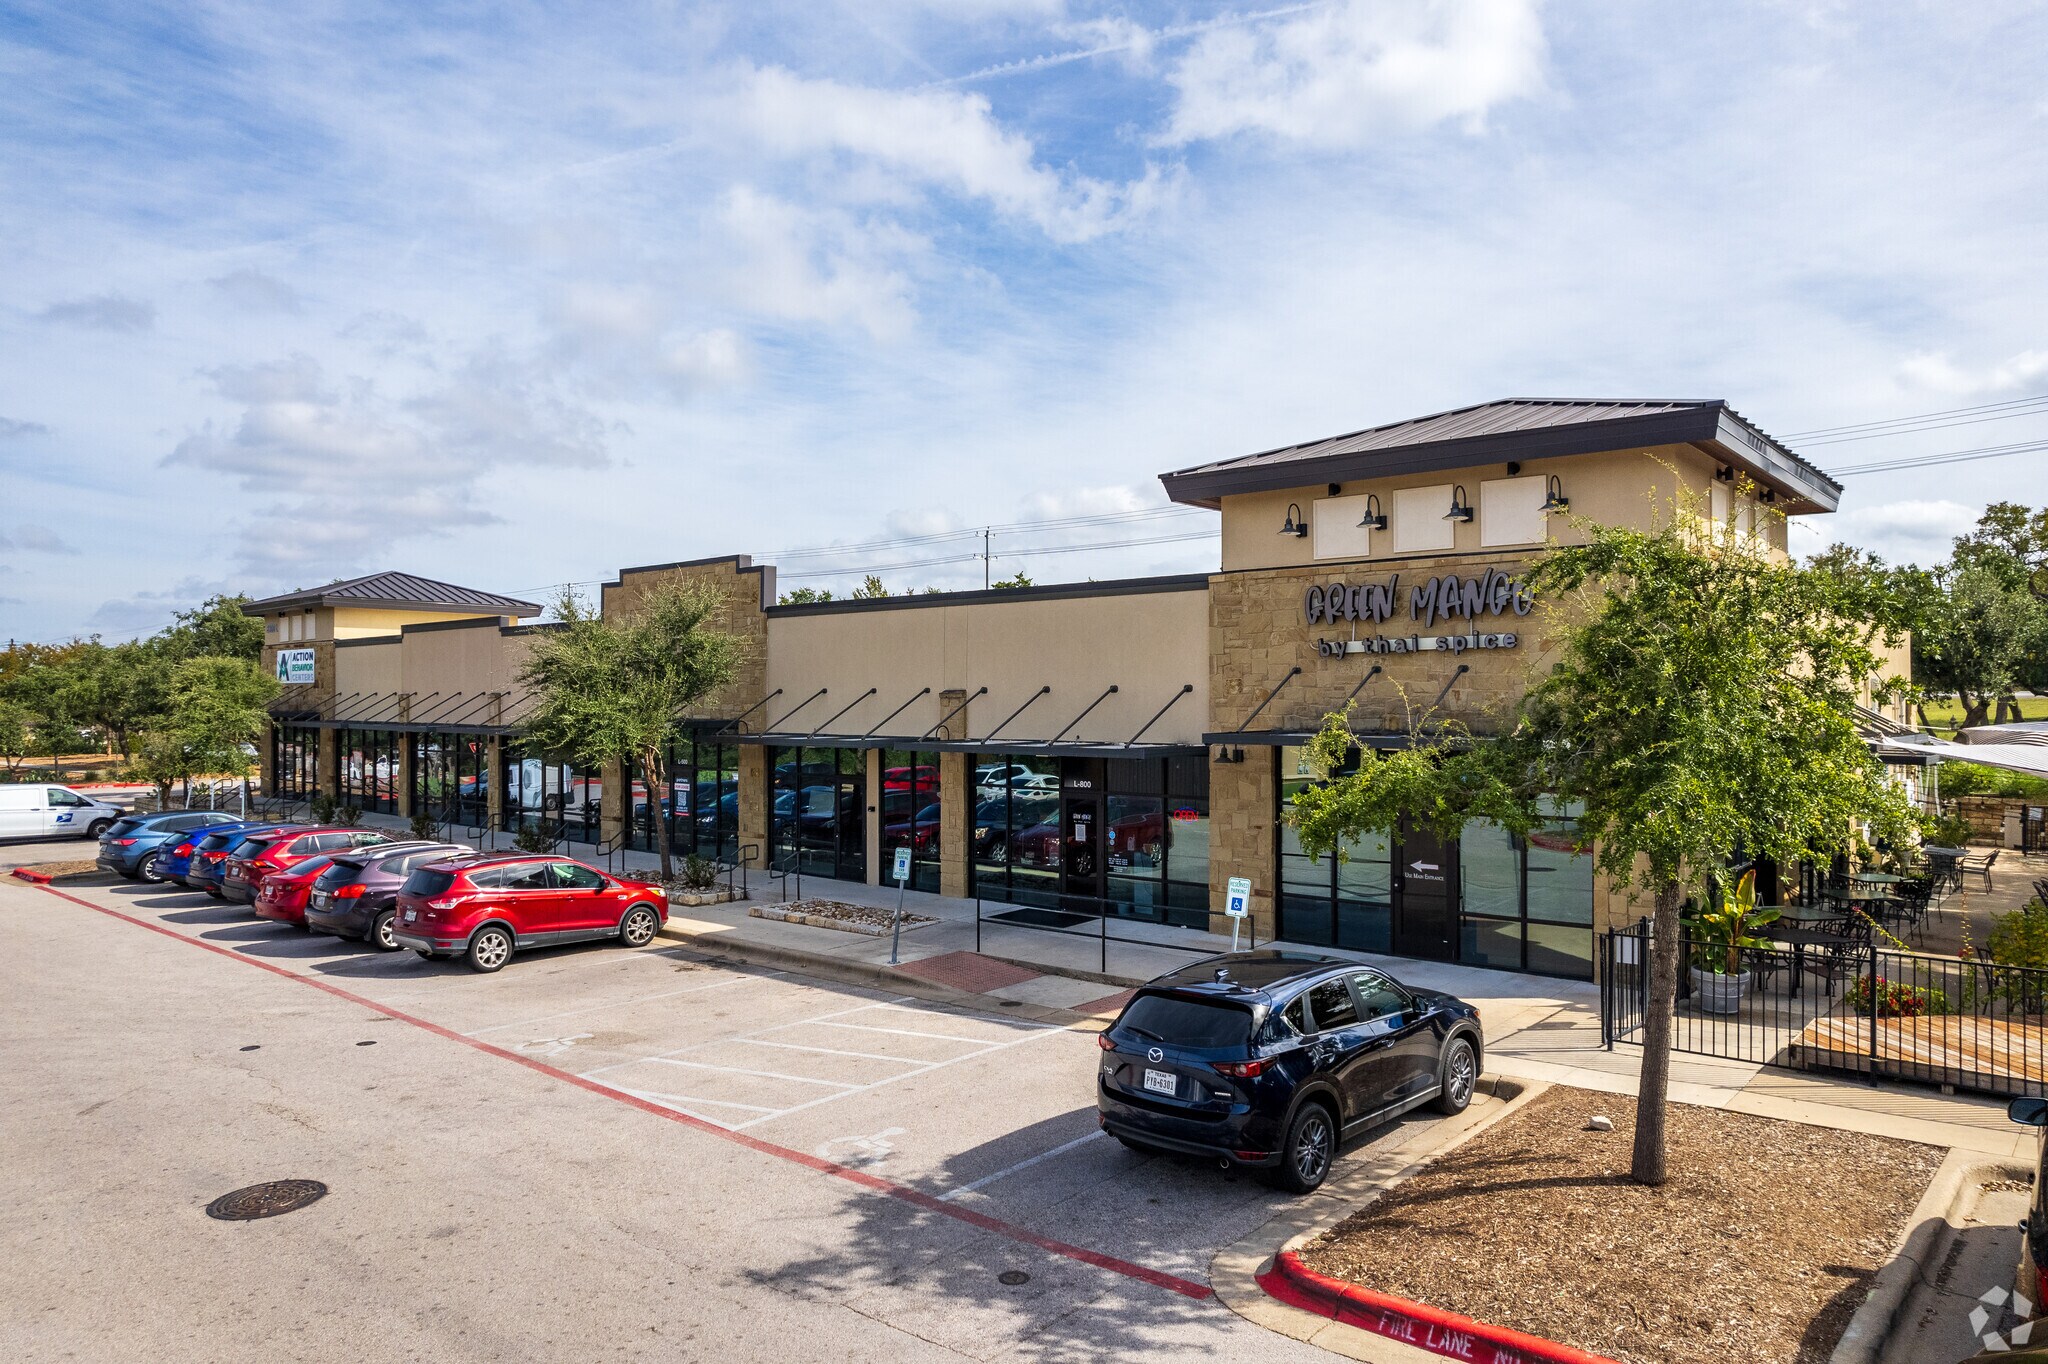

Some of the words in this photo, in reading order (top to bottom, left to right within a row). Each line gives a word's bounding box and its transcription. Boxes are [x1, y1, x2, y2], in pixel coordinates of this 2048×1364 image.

[1305, 573, 1399, 625] GREEN
[1410, 567, 1537, 628] MANGO
[1317, 638, 1347, 660] by
[1362, 634, 1419, 655] thai
[1436, 630, 1517, 655] spice
[292, 651, 314, 662] ACTION
[291, 663, 314, 672] BEHAVIOR
[292, 673, 314, 682] CENTERS
[1073, 780, 1092, 788] L-800
[1174, 809, 1199, 822] OPEN
[1231, 887, 1247, 895] PARKING
[1378, 1310, 1418, 1341] FIRE
[1426, 1324, 1475, 1358] LANE
